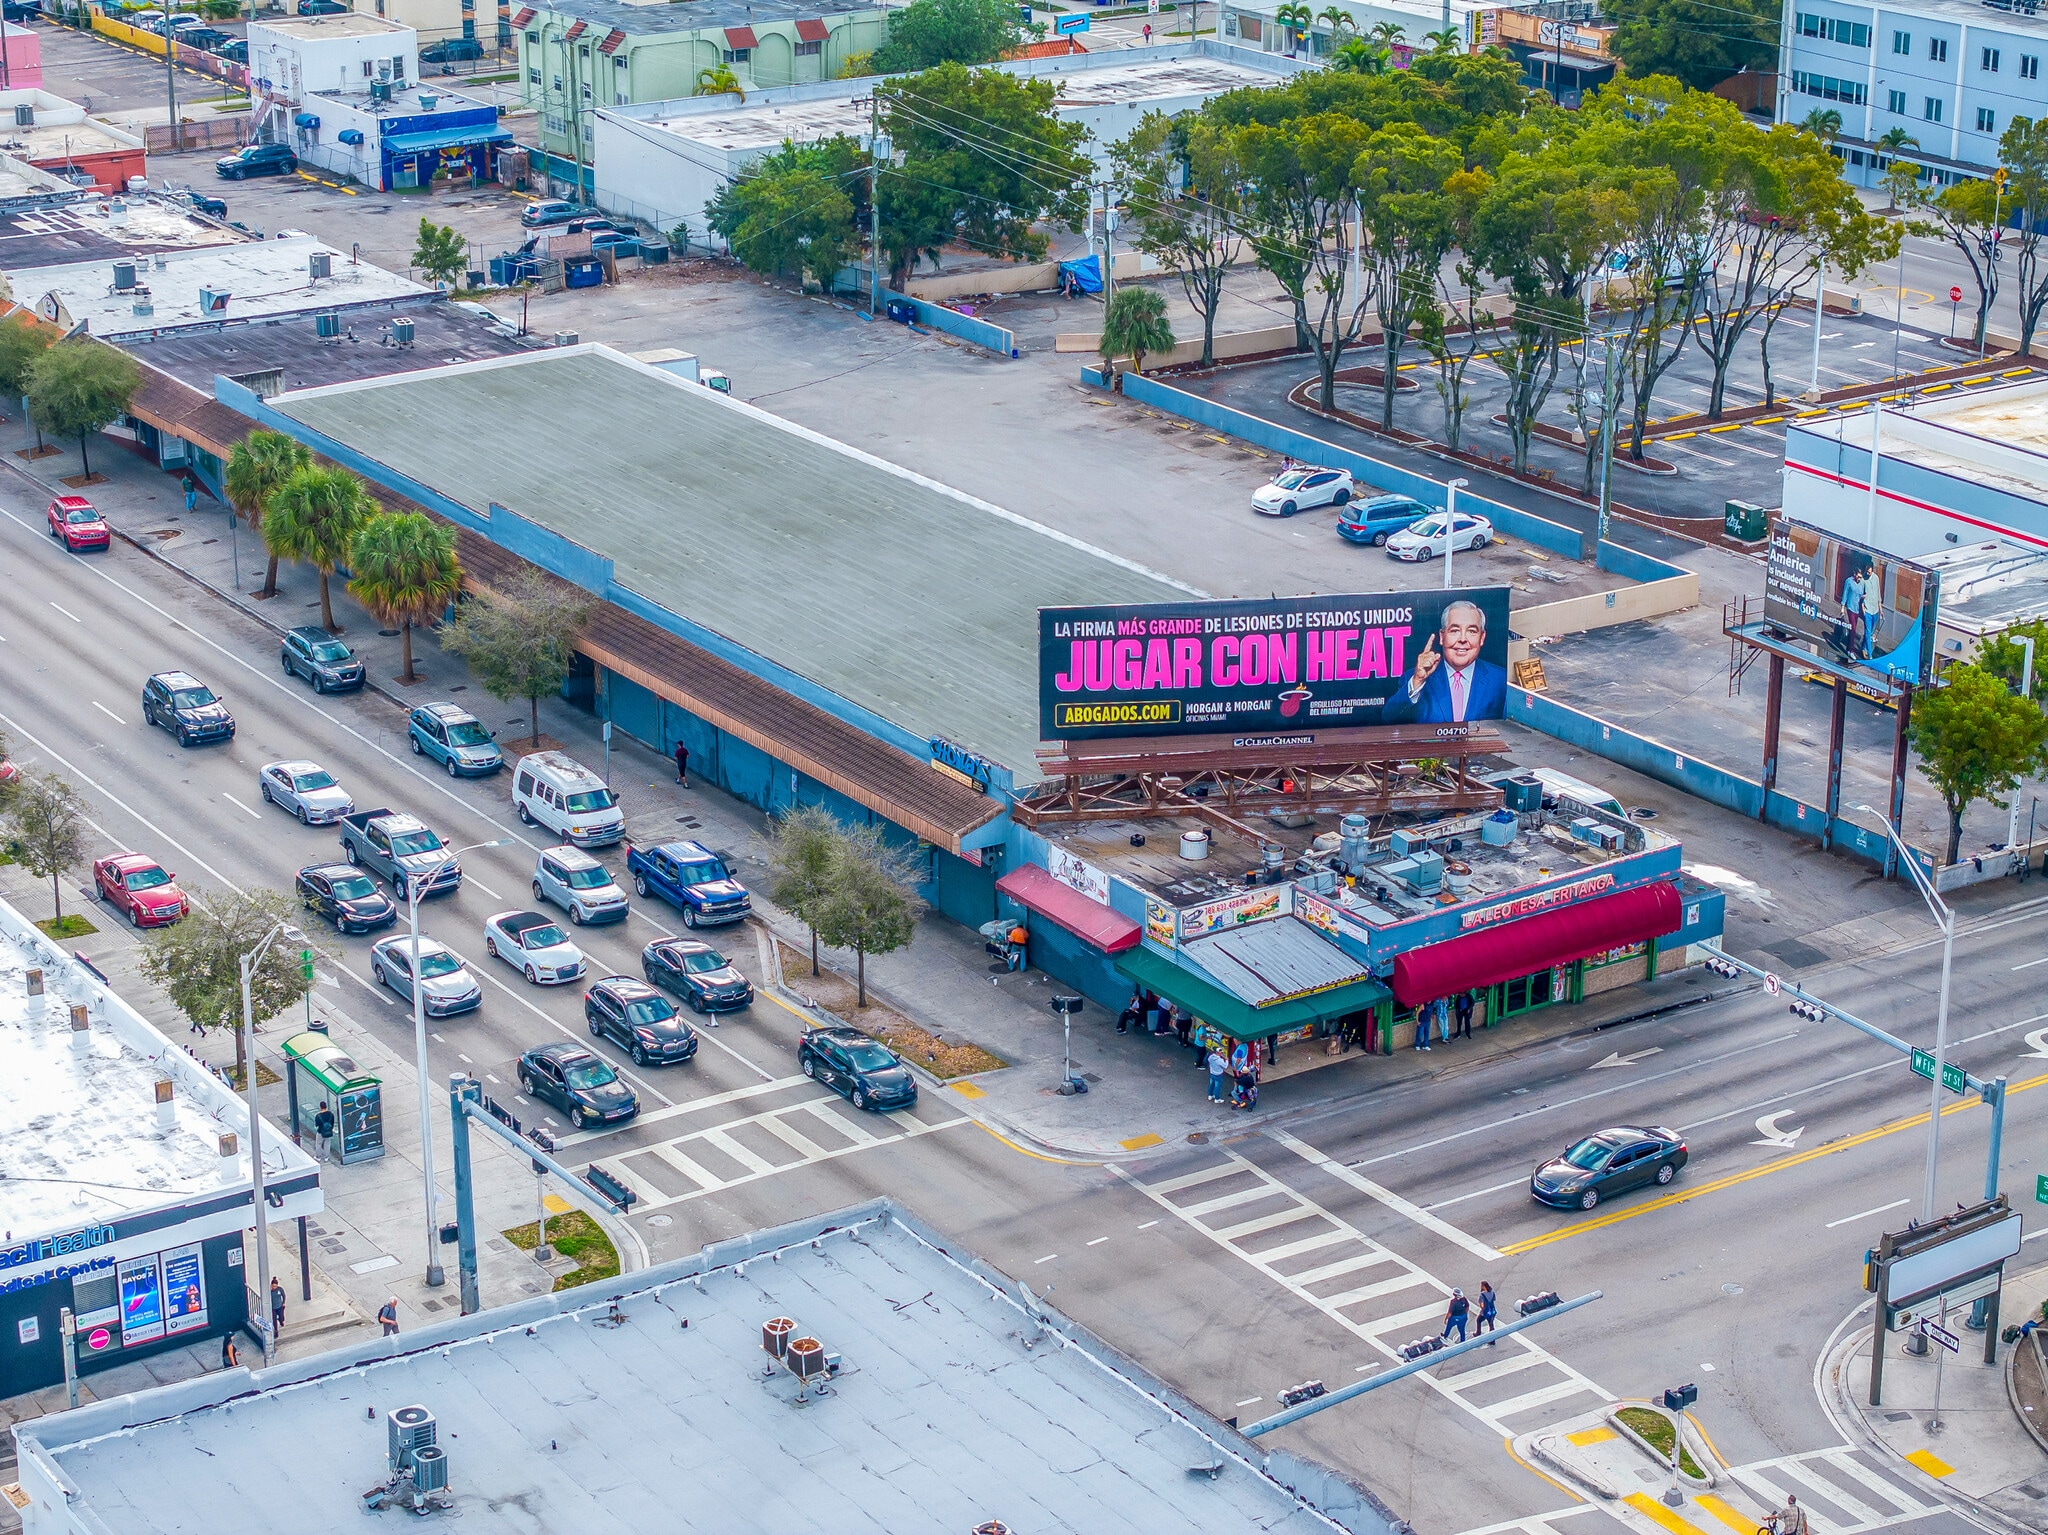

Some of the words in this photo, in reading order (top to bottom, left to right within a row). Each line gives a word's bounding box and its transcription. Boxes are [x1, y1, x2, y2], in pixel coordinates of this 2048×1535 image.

[1950, 290, 1961, 298] STOP
[1771, 531, 1796, 553] Latin
[1769, 548, 1811, 575] America
[1768, 565, 1774, 575] is
[1775, 566, 1804, 585] included
[1804, 577, 1812, 589] in
[1767, 577, 1779, 588] our
[1779, 581, 1805, 599] newest
[1805, 590, 1822, 604] plan
[1791, 601, 1800, 610] the
[1055, 622, 1071, 637] LA
[1073, 620, 1115, 637] FIRMA
[1118, 617, 1146, 636] MÁS
[1148, 619, 1202, 635] GRANDE
[1205, 618, 1221, 633] DE
[1224, 614, 1284, 632] LESIONES
[1286, 613, 1303, 629] DE
[1305, 610, 1361, 627] ESTADOS
[1363, 607, 1413, 625] UNIDOS
[1055, 638, 1202, 692] JUGAR
[1211, 632, 1298, 688] CON
[1306, 626, 1412, 682] HEAT
[1065, 704, 1171, 723] ABOGADOS.COM
[1185, 714, 1210, 723] OFICINAS
[1210, 713, 1227, 721] MIAMI
[1186, 702, 1223, 714] MORGAN
[1225, 702, 1232, 712] &
[1436, 727, 1468, 736] 004710
[1463, 913, 1482, 928] LA
[1485, 896, 1546, 922] LEONESA
[1551, 875, 1615, 903] FRITANGA
[1915, 1054, 1922, 1068] W
[1922, 1058, 1952, 1083] Flaer
[1952, 1074, 1960, 1087] St
[55, 1256, 116, 1281] Center
[122, 1272, 147, 1285] RAYOS
[147, 1270, 154, 1278] X
[1931, 1328, 1943, 1340] ONE
[1944, 1336, 1956, 1347] WAY
